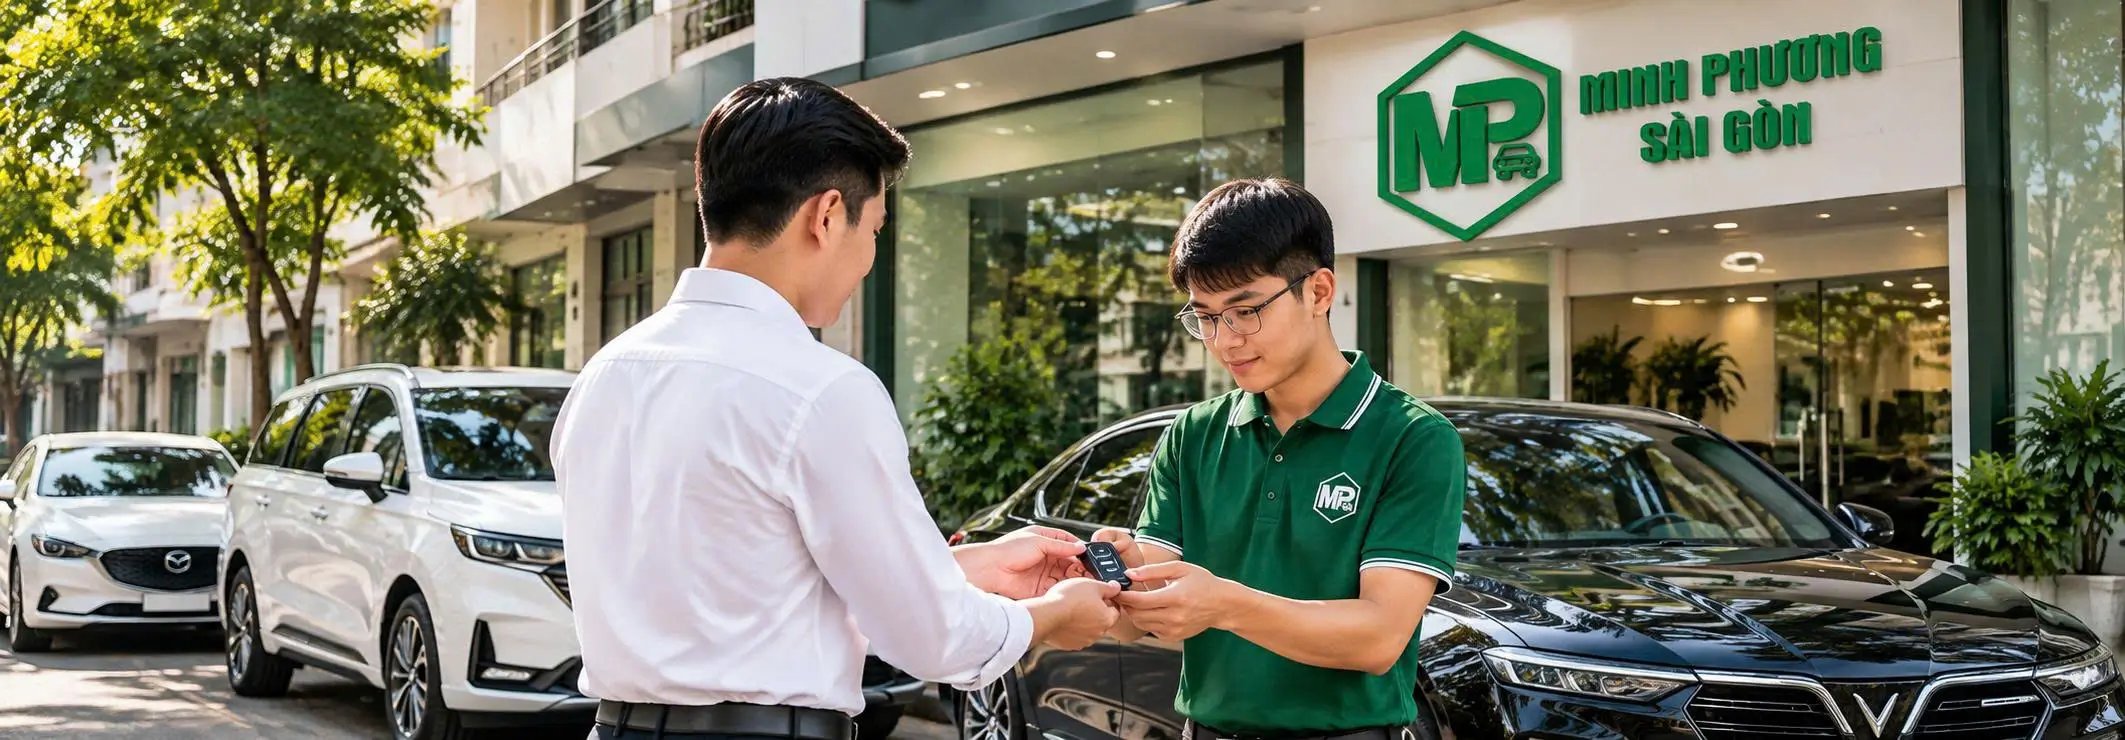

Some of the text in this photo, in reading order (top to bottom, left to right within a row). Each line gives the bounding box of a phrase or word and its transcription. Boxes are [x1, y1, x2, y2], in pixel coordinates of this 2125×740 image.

[1579, 26, 1883, 116] MINH PHƯƠNG
[1639, 98, 1813, 164] SÀI GÒN
